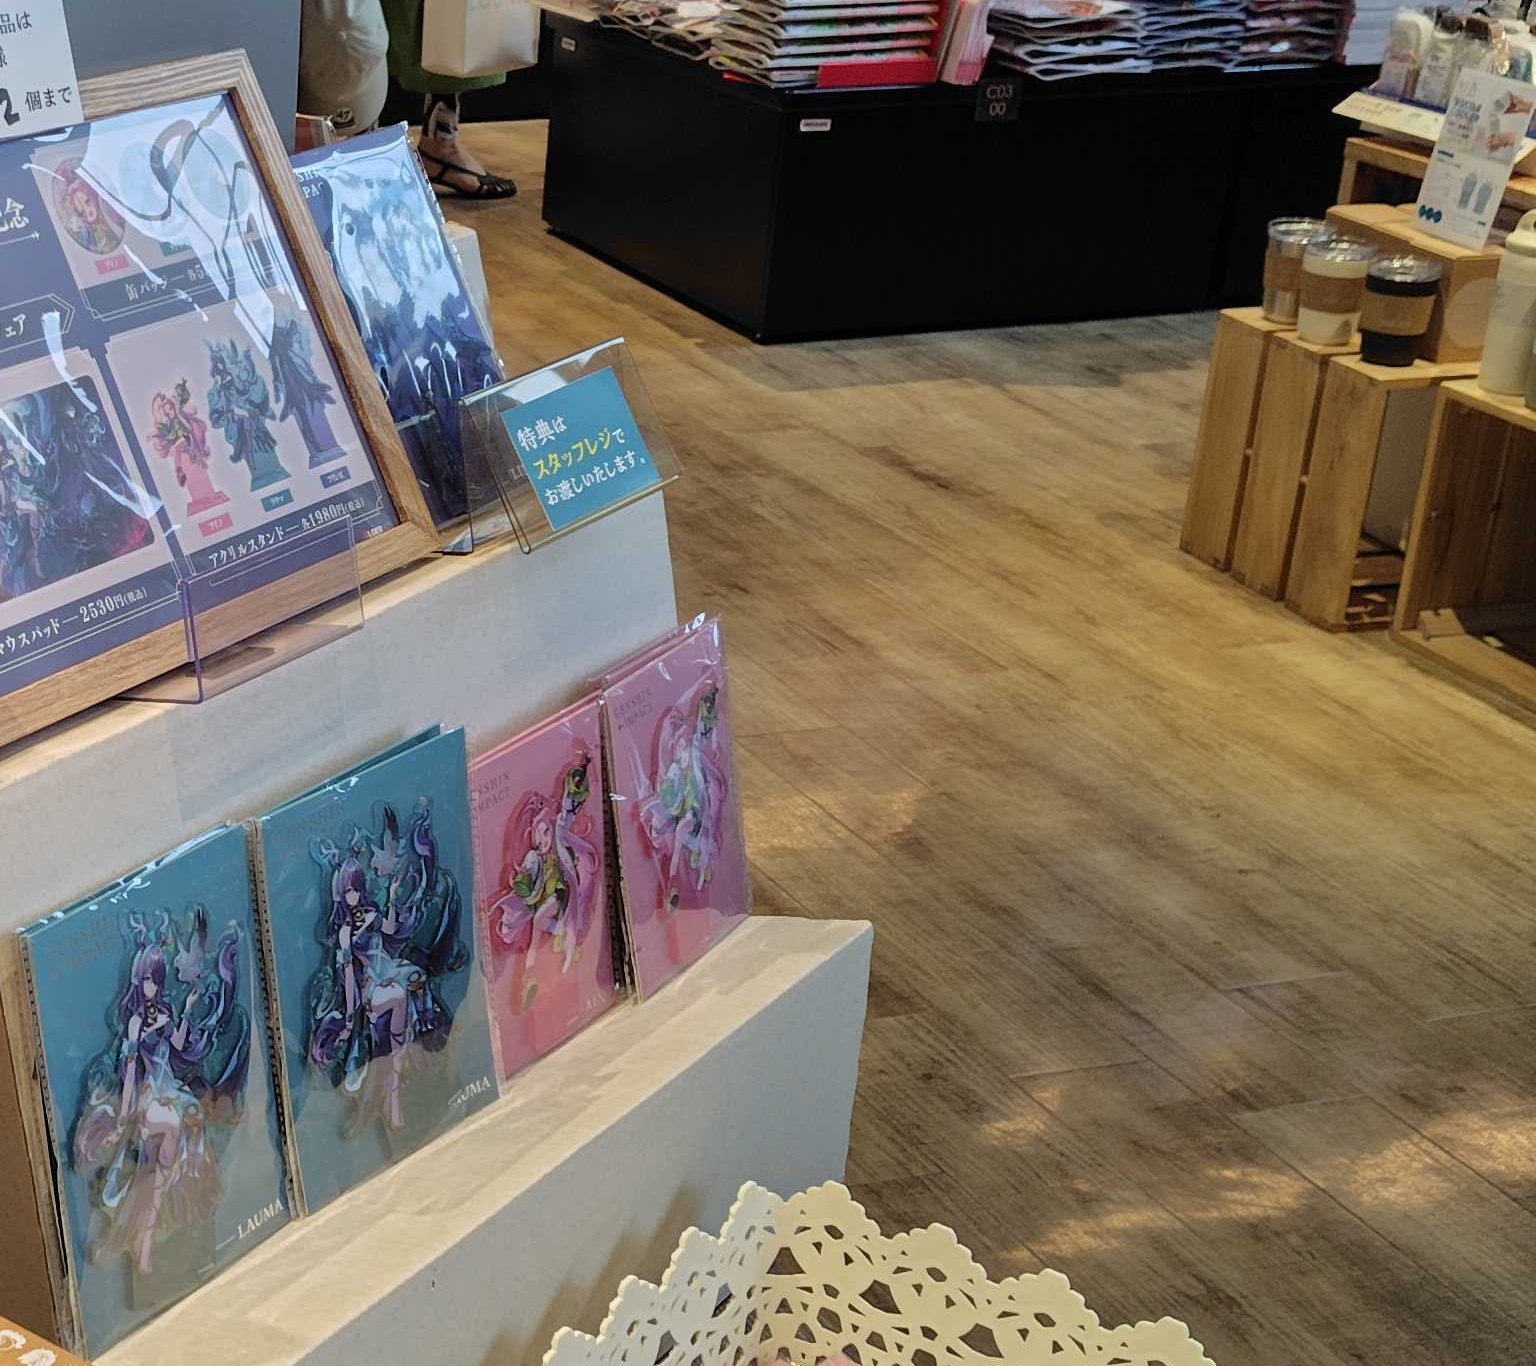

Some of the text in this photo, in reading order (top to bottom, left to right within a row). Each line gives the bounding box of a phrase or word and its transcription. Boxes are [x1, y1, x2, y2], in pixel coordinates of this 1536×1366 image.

[25, 86, 72, 112] 個まで
[516, 416, 568, 452] 特典は
[532, 427, 626, 480] スタッフレジで
[236, 1196, 285, 1240] LAUMA
